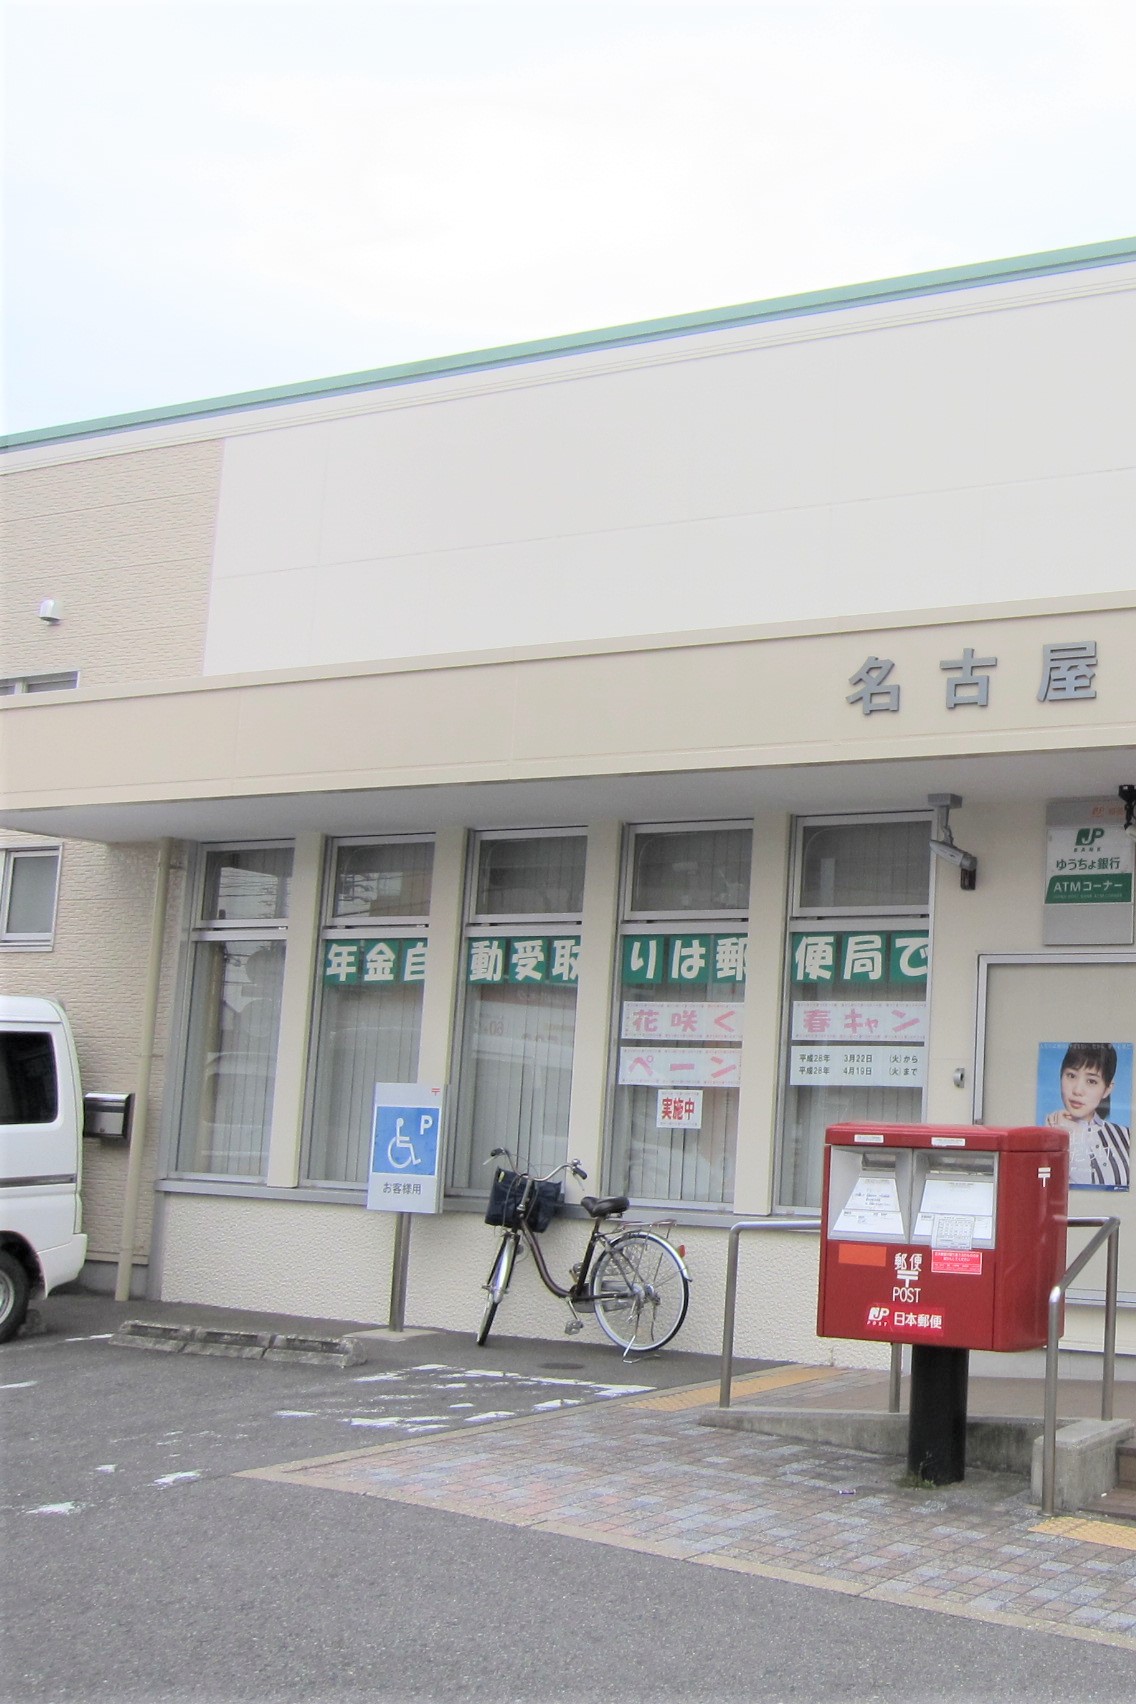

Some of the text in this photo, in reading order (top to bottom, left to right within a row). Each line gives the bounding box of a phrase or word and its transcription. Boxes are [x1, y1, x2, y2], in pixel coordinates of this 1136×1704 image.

[1056, 857, 1120, 870] ゆうちょ銀行
[1053, 880, 1122, 893] ATMコーナー
[632, 1008, 920, 1033] 花咲く 春キャン
[628, 1054, 737, 1078] ペーン
[799, 1054, 830, 1063] 平成28年
[844, 1054, 873, 1063] 3月22日
[799, 1066, 830, 1075] 平成28年
[843, 1066, 872, 1076] 4月19日
[661, 1097, 695, 1121] 実施中
[420, 1115, 433, 1135] P
[382, 1182, 422, 1195] お客様用
[894, 1252, 922, 1271] 郵便
[892, 1286, 921, 1303] POST
[894, 1311, 942, 1330] 日本郵便
